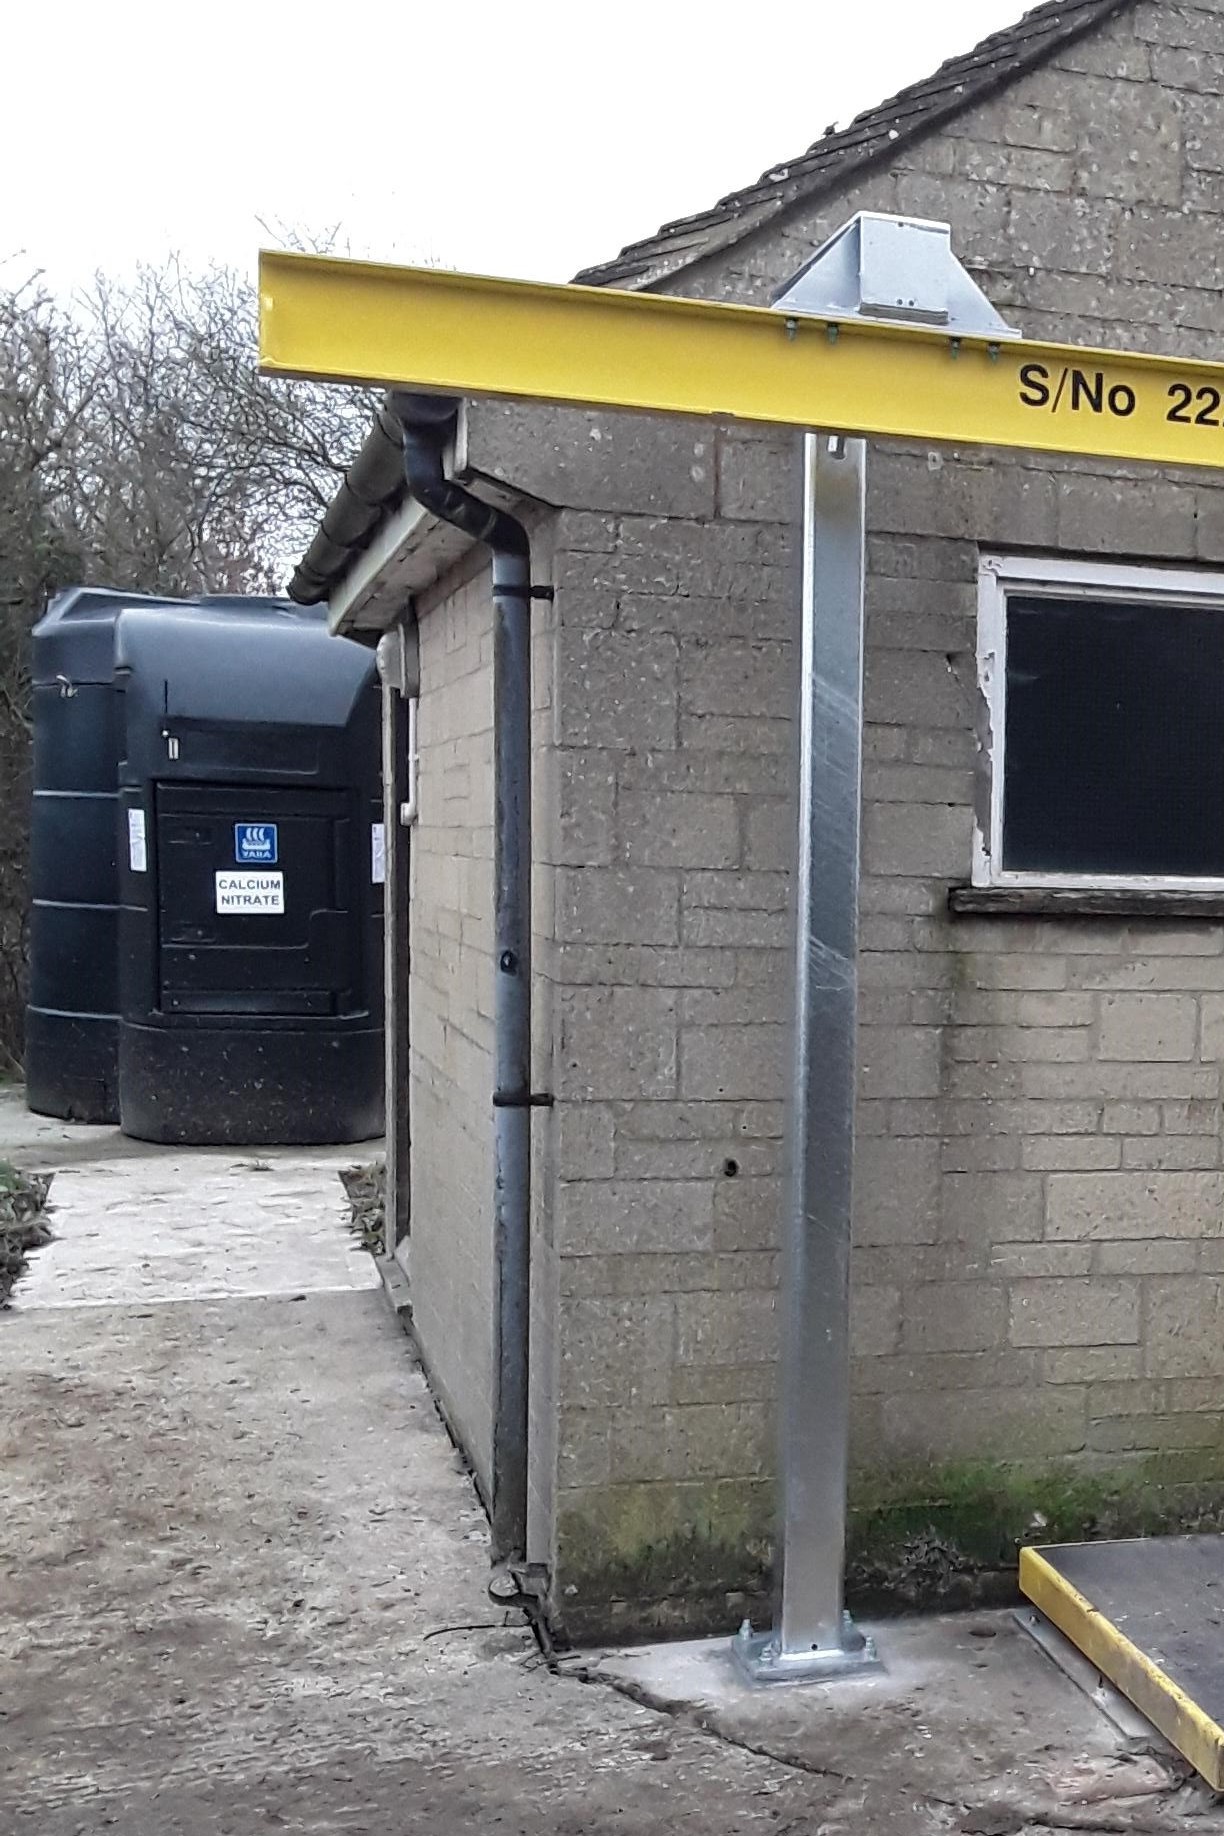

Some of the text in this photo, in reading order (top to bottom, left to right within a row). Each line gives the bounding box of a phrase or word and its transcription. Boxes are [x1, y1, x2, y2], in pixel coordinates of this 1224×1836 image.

[1018, 363, 1136, 417] S/No
[218, 878, 282, 891] CALCIUM
[220, 894, 280, 907] NITRATE
